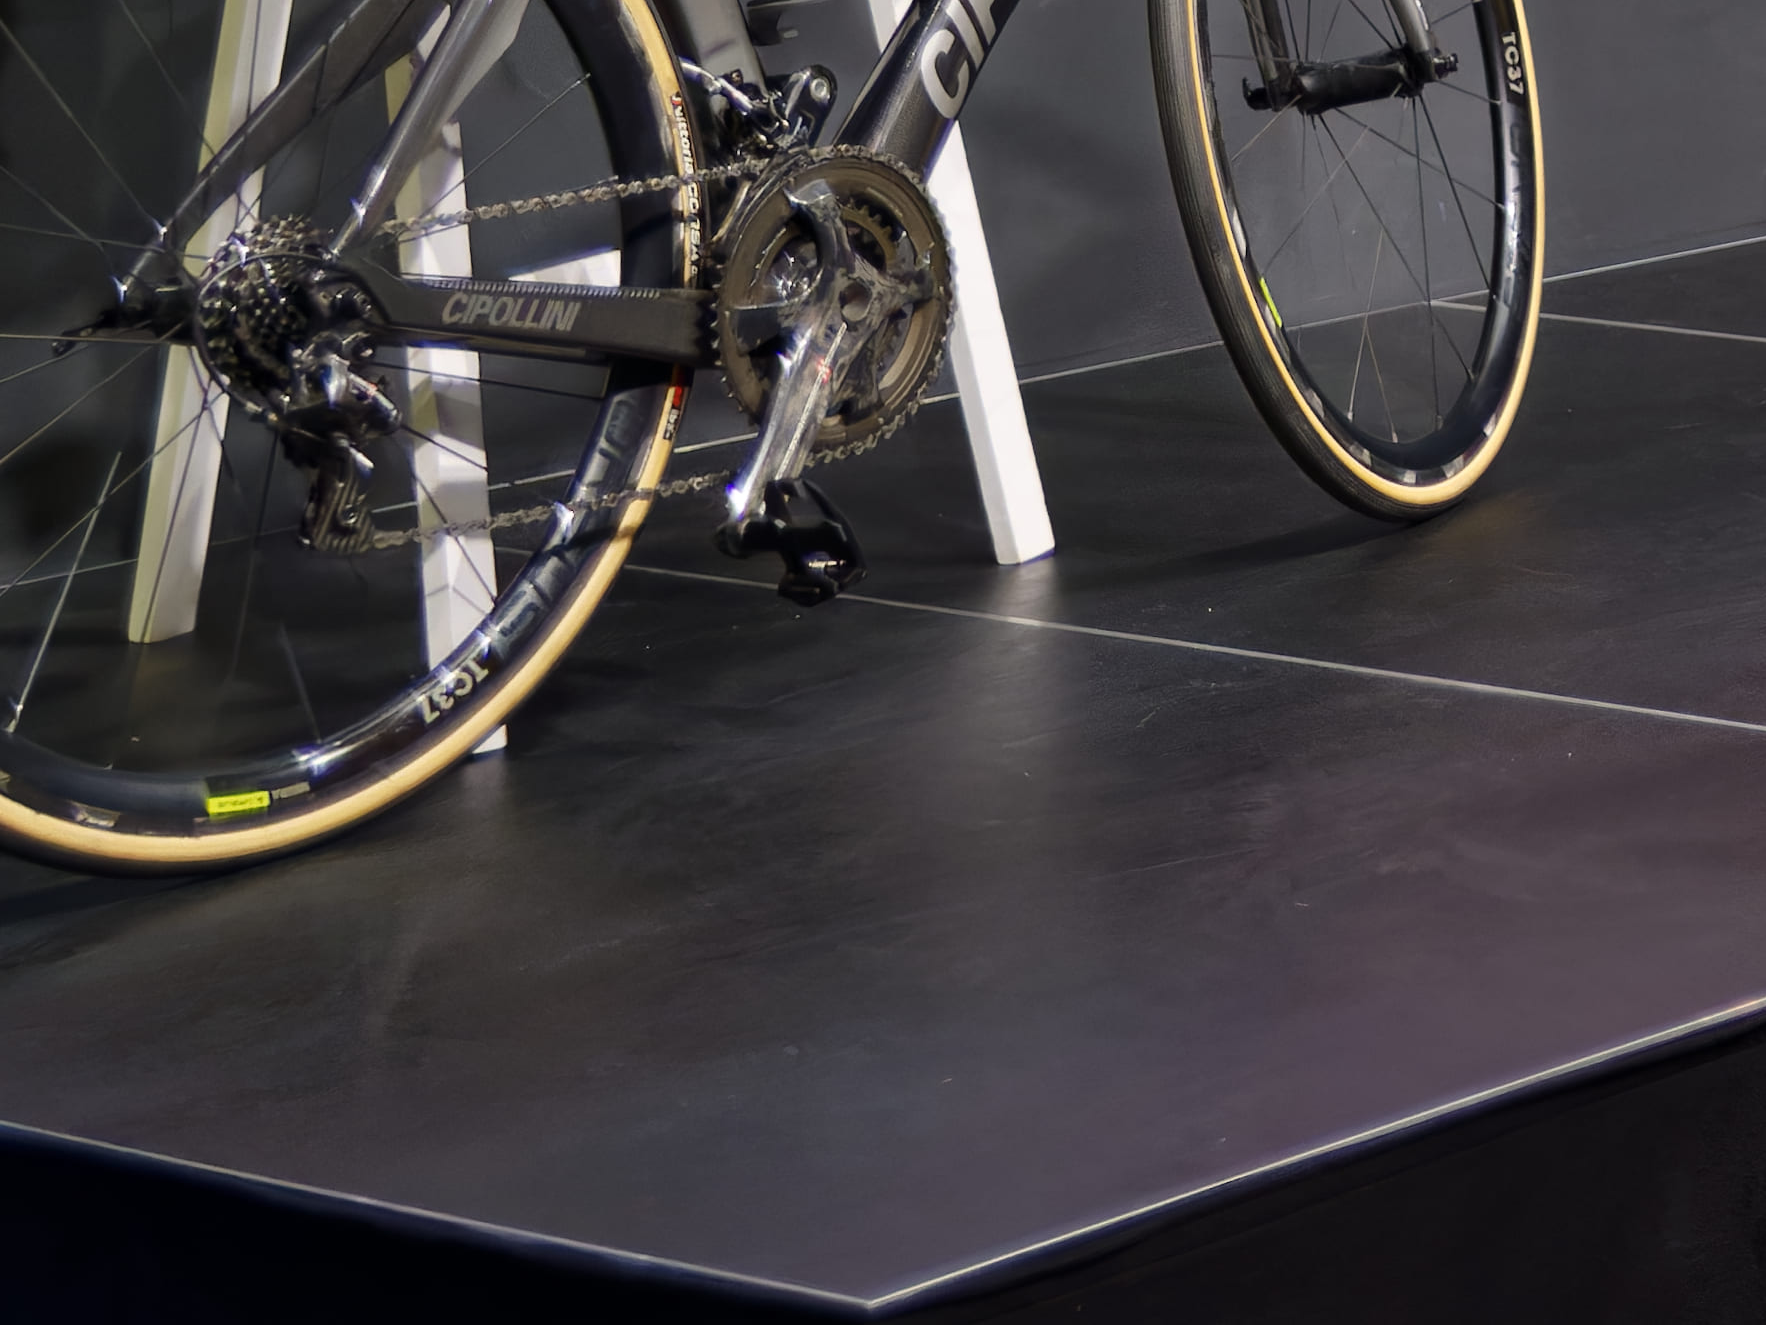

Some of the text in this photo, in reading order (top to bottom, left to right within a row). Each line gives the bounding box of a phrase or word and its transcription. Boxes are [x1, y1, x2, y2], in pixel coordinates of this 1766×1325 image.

[1503, 31, 1525, 97] TC37
[441, 291, 581, 332] CIPOLLINI
[424, 655, 489, 725] TC37
